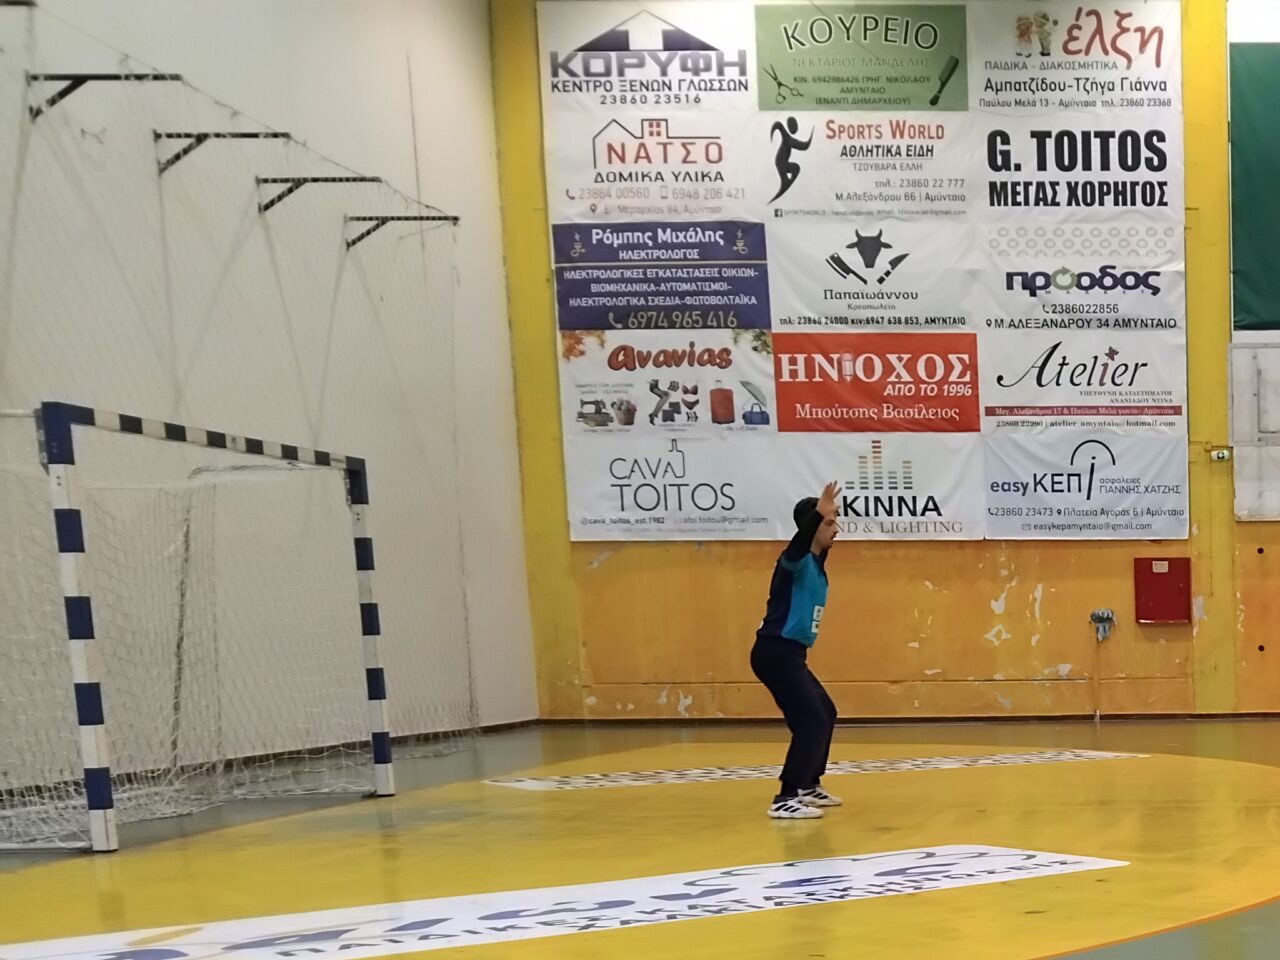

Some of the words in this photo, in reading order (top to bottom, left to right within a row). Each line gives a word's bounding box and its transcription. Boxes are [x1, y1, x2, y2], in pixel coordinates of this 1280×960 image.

[783, 15, 938, 50] ΚΟΥΡΕΙΟ
[1062, 6, 1164, 70] έλξη
[550, 50, 748, 78] ΚΟΡΥΦΗ
[985, 61, 1028, 70] ΠΑΙΔΙΚΑ
[1039, 61, 1118, 70] ΔΙΑΚΟΣΜΗΤΙΚΑ
[551, 79, 613, 93] ΚΕΝΤΡΟ
[619, 80, 672, 92] ΞΕΝΩΝ
[678, 79, 748, 92] ΓΛΩΣΣΩΝ
[1121, 77, 1167, 92] Γιάννα
[600, 95, 648, 104] 23860
[654, 94, 701, 104] 23516
[1040, 98, 1049, 107] 13
[607, 142, 723, 164] ΝΑΤΣΟ
[840, 145, 902, 157] ΑΘΛΗΤΙΚΑ
[906, 145, 934, 157] ΕΙΔΗ
[987, 129, 1022, 172] G.
[1030, 129, 1167, 172] TOITOS
[853, 163, 897, 171] ΤΖΟΥΒΑΡΑ
[900, 163, 923, 171] ΕΛΛΗ
[594, 171, 664, 183] ΔΟΜΙΚΑ
[672, 171, 724, 182] ΥΛΙΚΑ
[899, 179, 928, 188] 23860
[932, 179, 944, 187] 22
[948, 179, 965, 187] 777
[904, 192, 916, 201] 66
[925, 192, 966, 202] Αμύνταιο
[989, 181, 1060, 206] ΜΕΓΑΣ
[1066, 181, 1168, 206] ΧΟΡΗΓΟΣ
[592, 228, 652, 247] Ρόμπης
[658, 227, 724, 245] Μιχάλης
[619, 249, 700, 259] ΗΛΕΚΤΡΟΛΟΓΟΣ
[564, 269, 644, 279] ΗΛΕΚΤΡΟΛΟΓΙΚΕΣ
[647, 268, 719, 278] ΕΓΚΑΤΑΣΤΑΣΕΙΣ
[824, 289, 918, 300] Παπαϊωάννου
[569, 297, 645, 306] ΗΛΕΚΤΡΟΛΟΓΙΚΑ
[1052, 304, 1119, 313] 2386022856
[628, 312, 667, 328] 6974
[672, 312, 702, 328] 965
[707, 312, 737, 328] 416
[925, 317, 965, 325] ΑΜΥΝΤΑΙΟ
[995, 319, 1093, 328] Μ.ΑΛΕΞΑΝΔΡΟΥ
[1097, 319, 1109, 328] 34
[1113, 318, 1177, 328] ΑΜΥΝΤΑΙΟ
[778, 353, 971, 382] ΗΝΙΟΧΟΣ
[997, 341, 1148, 387] Atelier
[884, 385, 915, 396] ΑΠΟ
[920, 385, 937, 396] ΤΟ
[943, 385, 972, 396] 1996
[796, 404, 878, 420] Μπούτσης
[882, 404, 959, 420] Βασίλειος
[609, 458, 685, 479] CAVA
[991, 480, 1029, 496] easy
[1100, 486, 1141, 494] ΓΙΑΝΝΗΣ
[1144, 485, 1180, 494] ΧΑΤΖΗΣ
[611, 483, 735, 511] TOITOS
[836, 496, 942, 517] KINNA
[994, 508, 1023, 516] 23860
[1026, 508, 1053, 516] 23473
[1063, 508, 1097, 517] Πλατεία
[1146, 508, 1184, 518] Αμύνταιο
[863, 522, 874, 533] &
[881, 522, 963, 533] LIGHTING
[1034, 523, 1152, 531] easykepamyntaio@gmail.com
[272, 914, 622, 957] ΠΑΙΔΙΚΕΣ
[633, 859, 1085, 914] ΚΑΤΑΣΚΗΝΩΣΕΙΣ
[570, 885, 945, 931] ΧΑΛΚΙΔΙΚΗΣ
